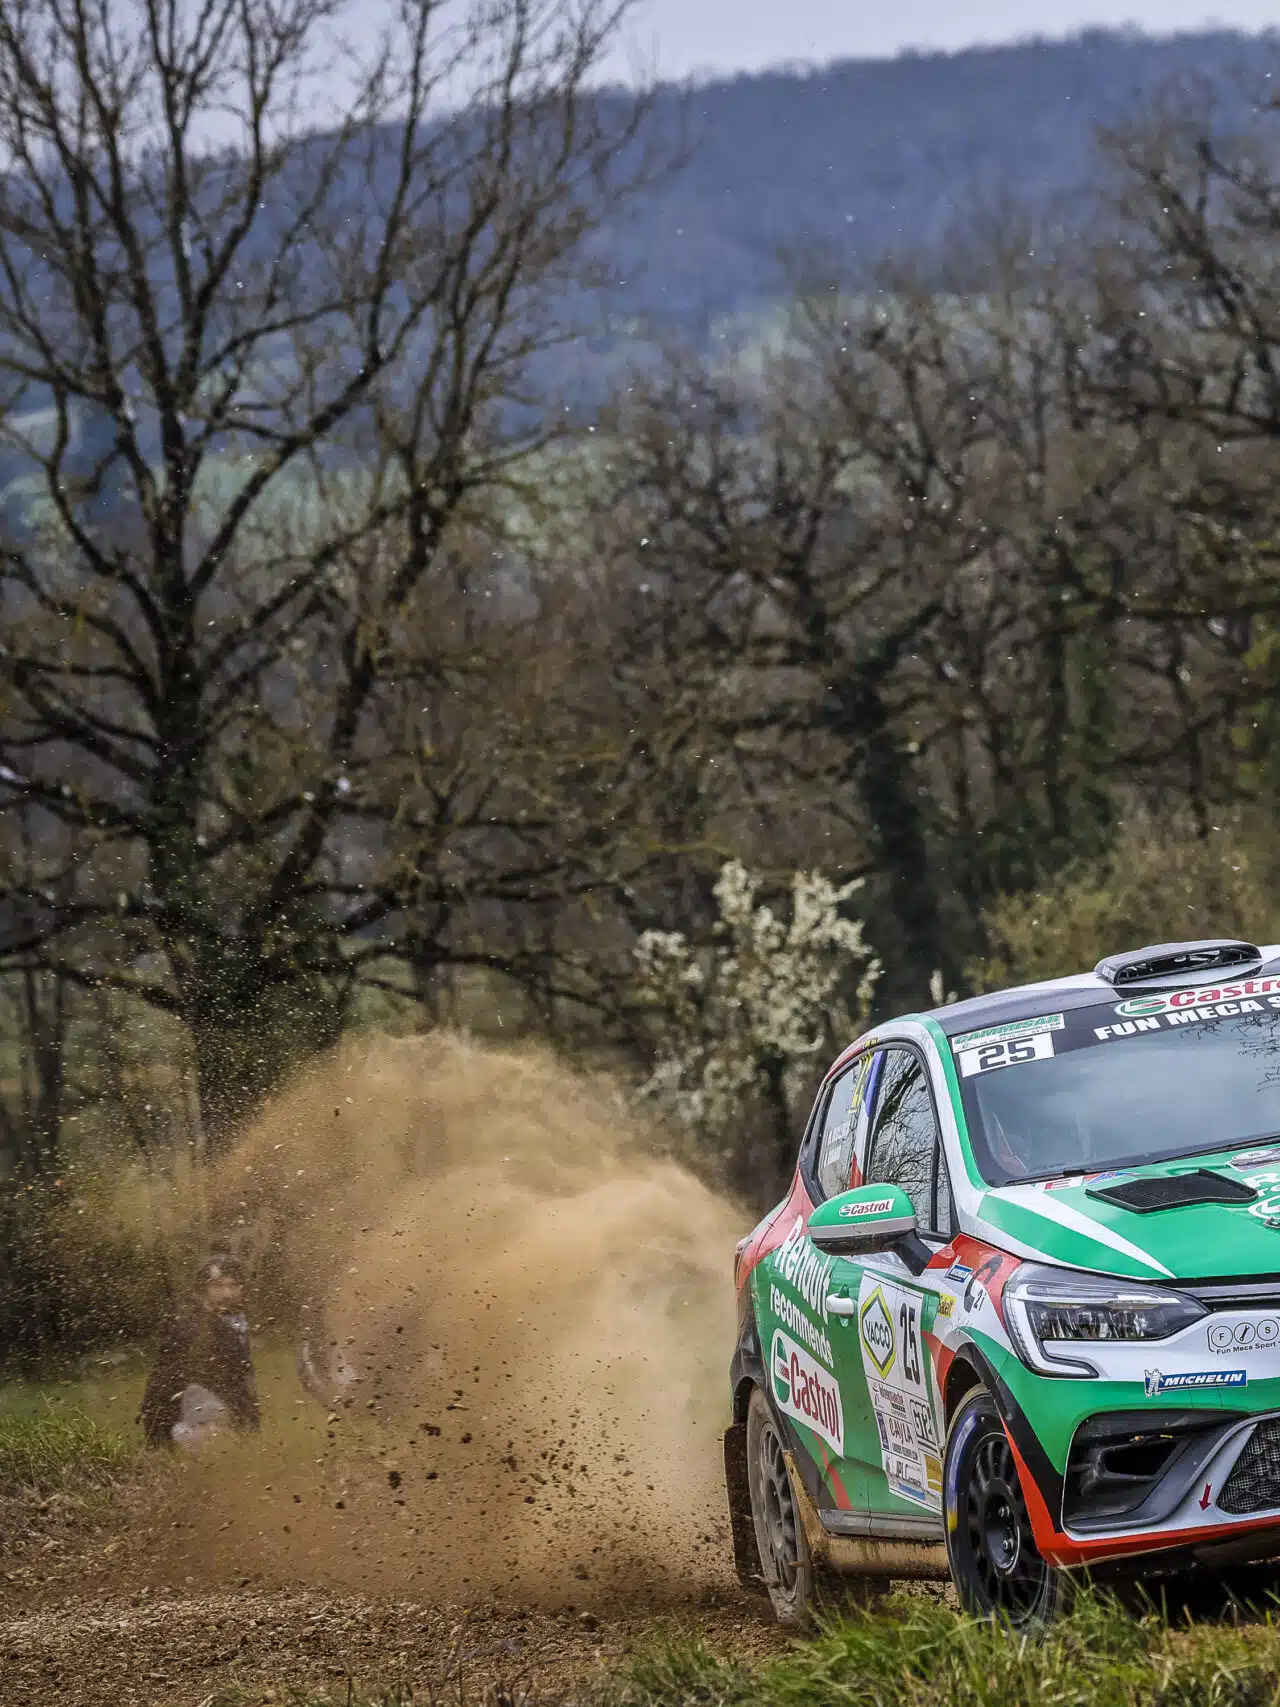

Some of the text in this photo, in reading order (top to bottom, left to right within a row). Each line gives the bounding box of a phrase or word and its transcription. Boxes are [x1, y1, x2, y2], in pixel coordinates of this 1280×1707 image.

[1093, 1016, 1162, 1041] FUN
[1167, 998, 1265, 1026] MECA
[977, 1037, 1036, 1071] 25
[850, 1200, 890, 1216] Castrol
[770, 1282, 834, 1369] recommends
[865, 1319, 891, 1350] YACCO
[899, 1302, 921, 1386] 25
[1216, 1341, 1277, 1355] Fun Meca Sport
[1164, 1372, 1243, 1387] MICHELIN
[790, 1351, 841, 1445] Castrol
